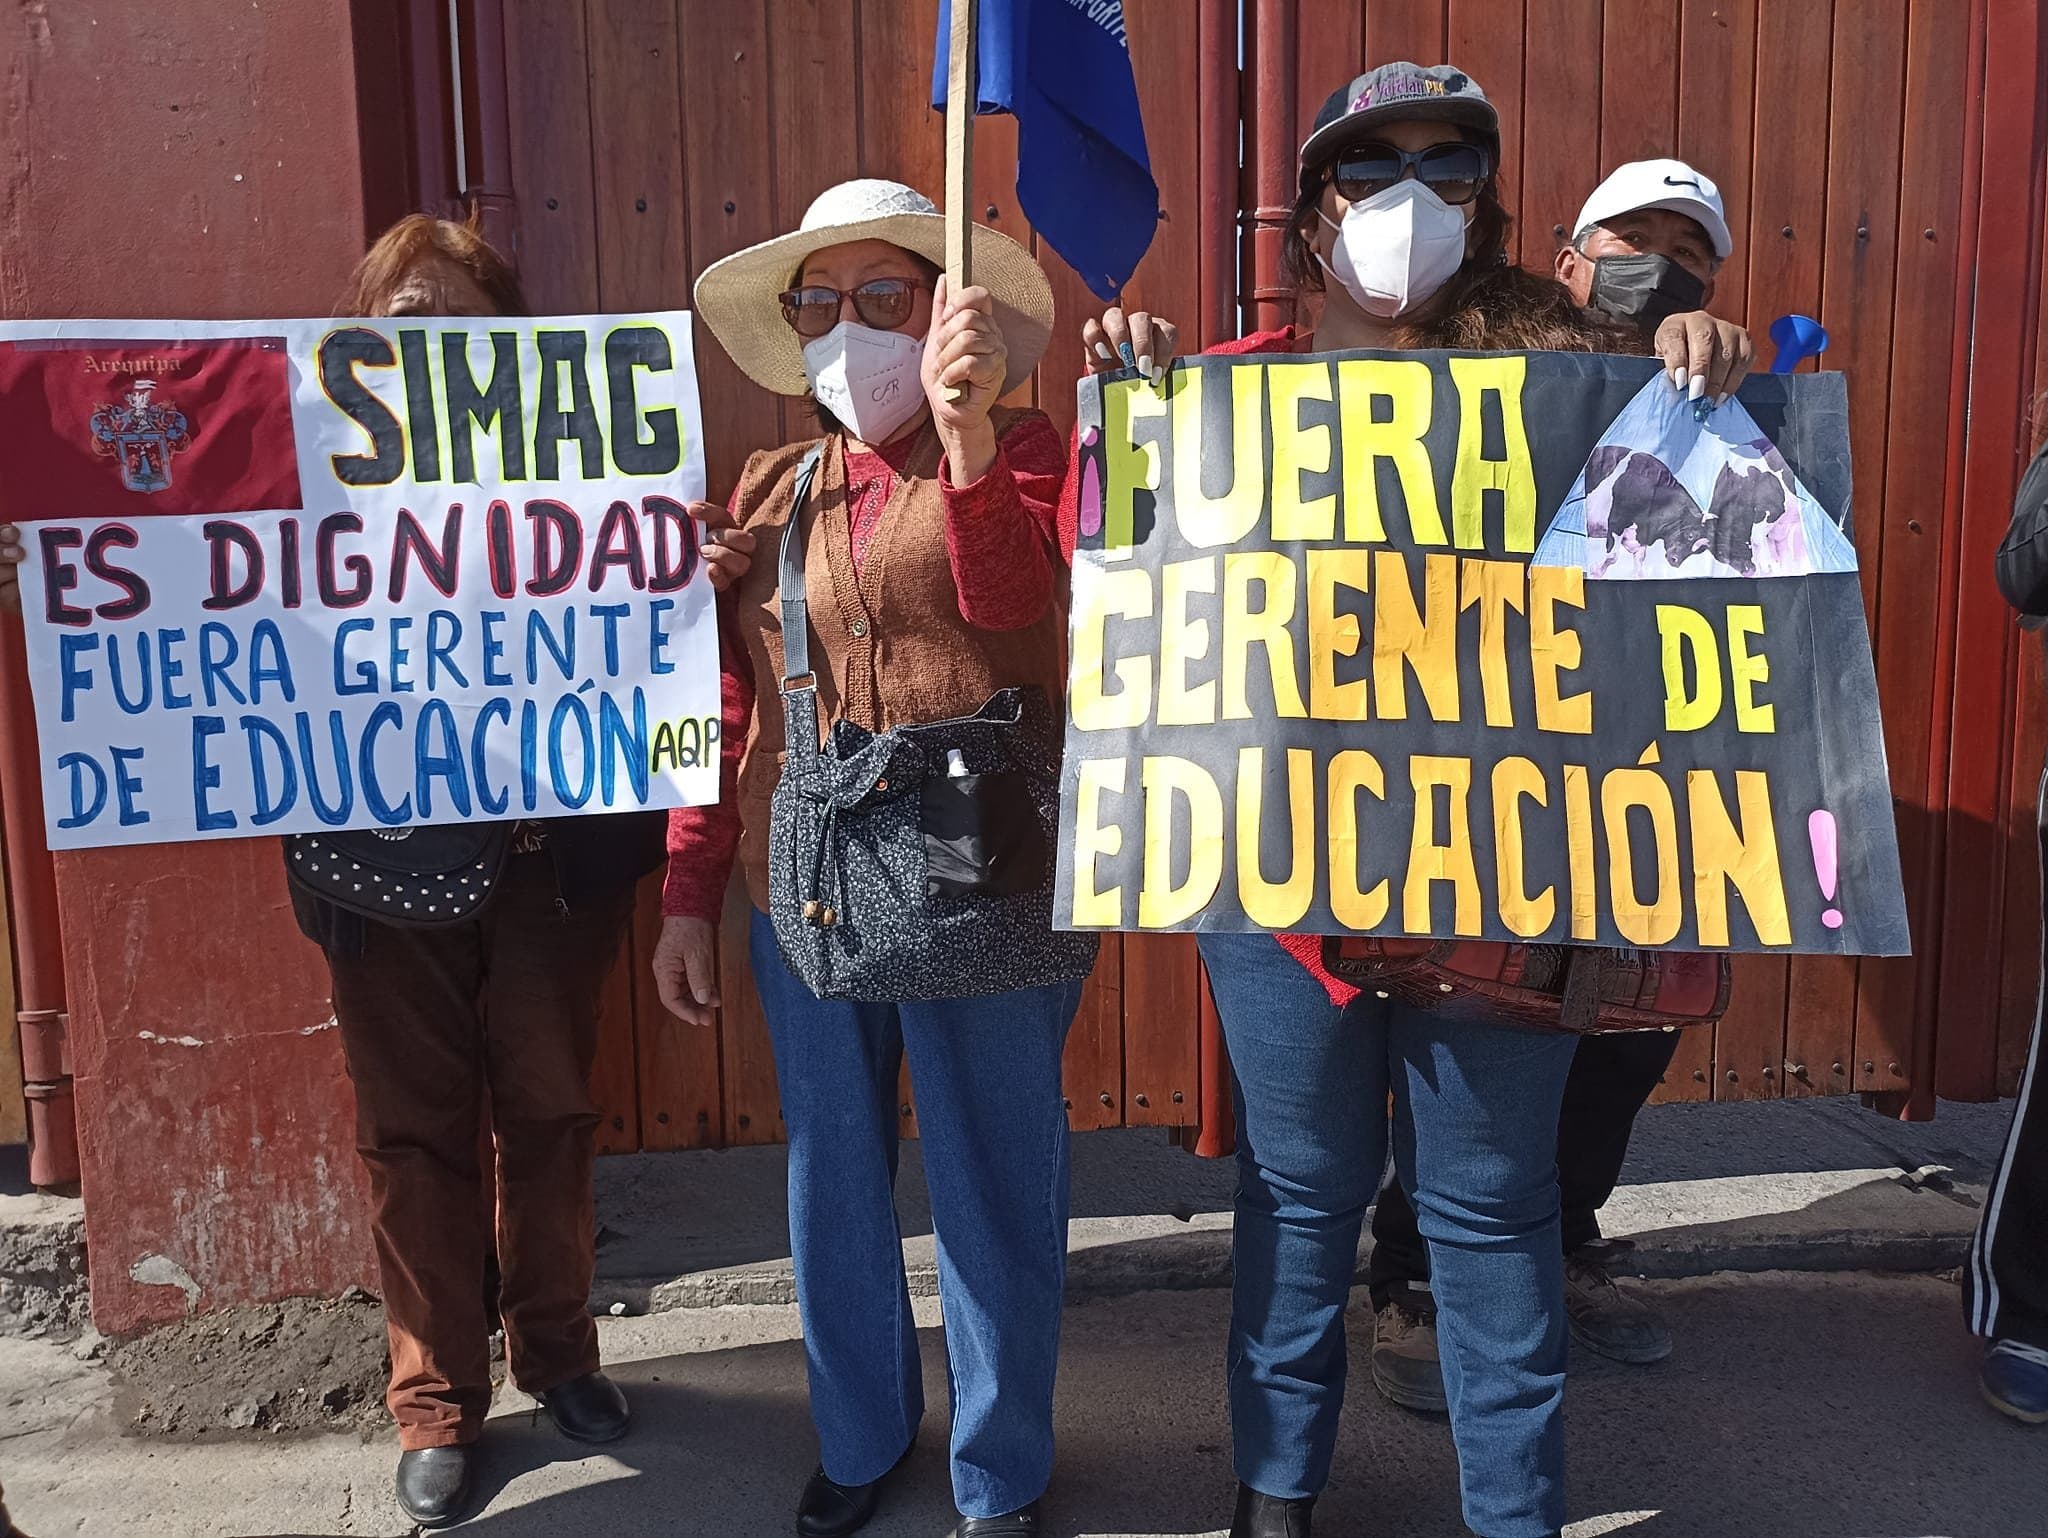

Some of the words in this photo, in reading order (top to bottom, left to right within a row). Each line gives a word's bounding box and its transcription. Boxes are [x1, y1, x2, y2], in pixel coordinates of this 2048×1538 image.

[83, 355, 182, 375] Arequipa
[317, 327, 687, 485] SIMAG
[40, 523, 151, 626] ES
[201, 495, 699, 609] DIGNIDAD
[59, 616, 297, 722] FUERA
[333, 598, 676, 696] GERENTE
[1070, 550, 1592, 734] GERENTE
[1656, 604, 1776, 734] DE
[57, 745, 152, 829] DE
[193, 678, 649, 831] EDUCACIÓN
[652, 716, 720, 773] AQP
